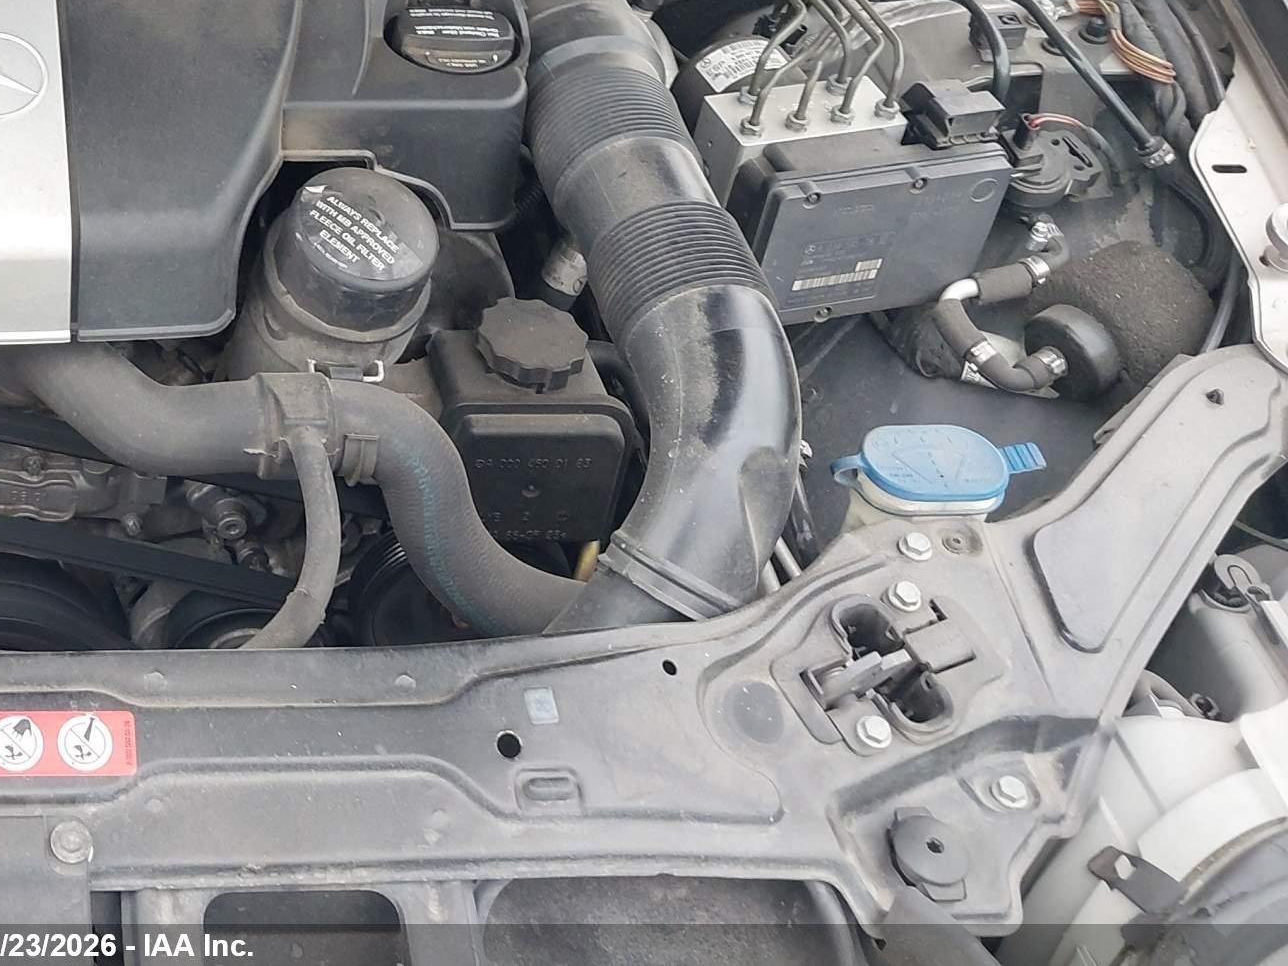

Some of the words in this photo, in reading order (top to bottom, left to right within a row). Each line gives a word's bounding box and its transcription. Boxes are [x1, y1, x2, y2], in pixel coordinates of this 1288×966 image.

[309, 210, 343, 235] FLEECE
[341, 232, 357, 247] OIL
[356, 243, 386, 271] FILTER
[315, 200, 337, 218] WITH
[336, 213, 353, 228] MB
[350, 224, 395, 265] APPROVED
[319, 229, 360, 263] ELEMENT
[326, 196, 362, 222] ALWAYS
[360, 217, 399, 253] REPLACE
